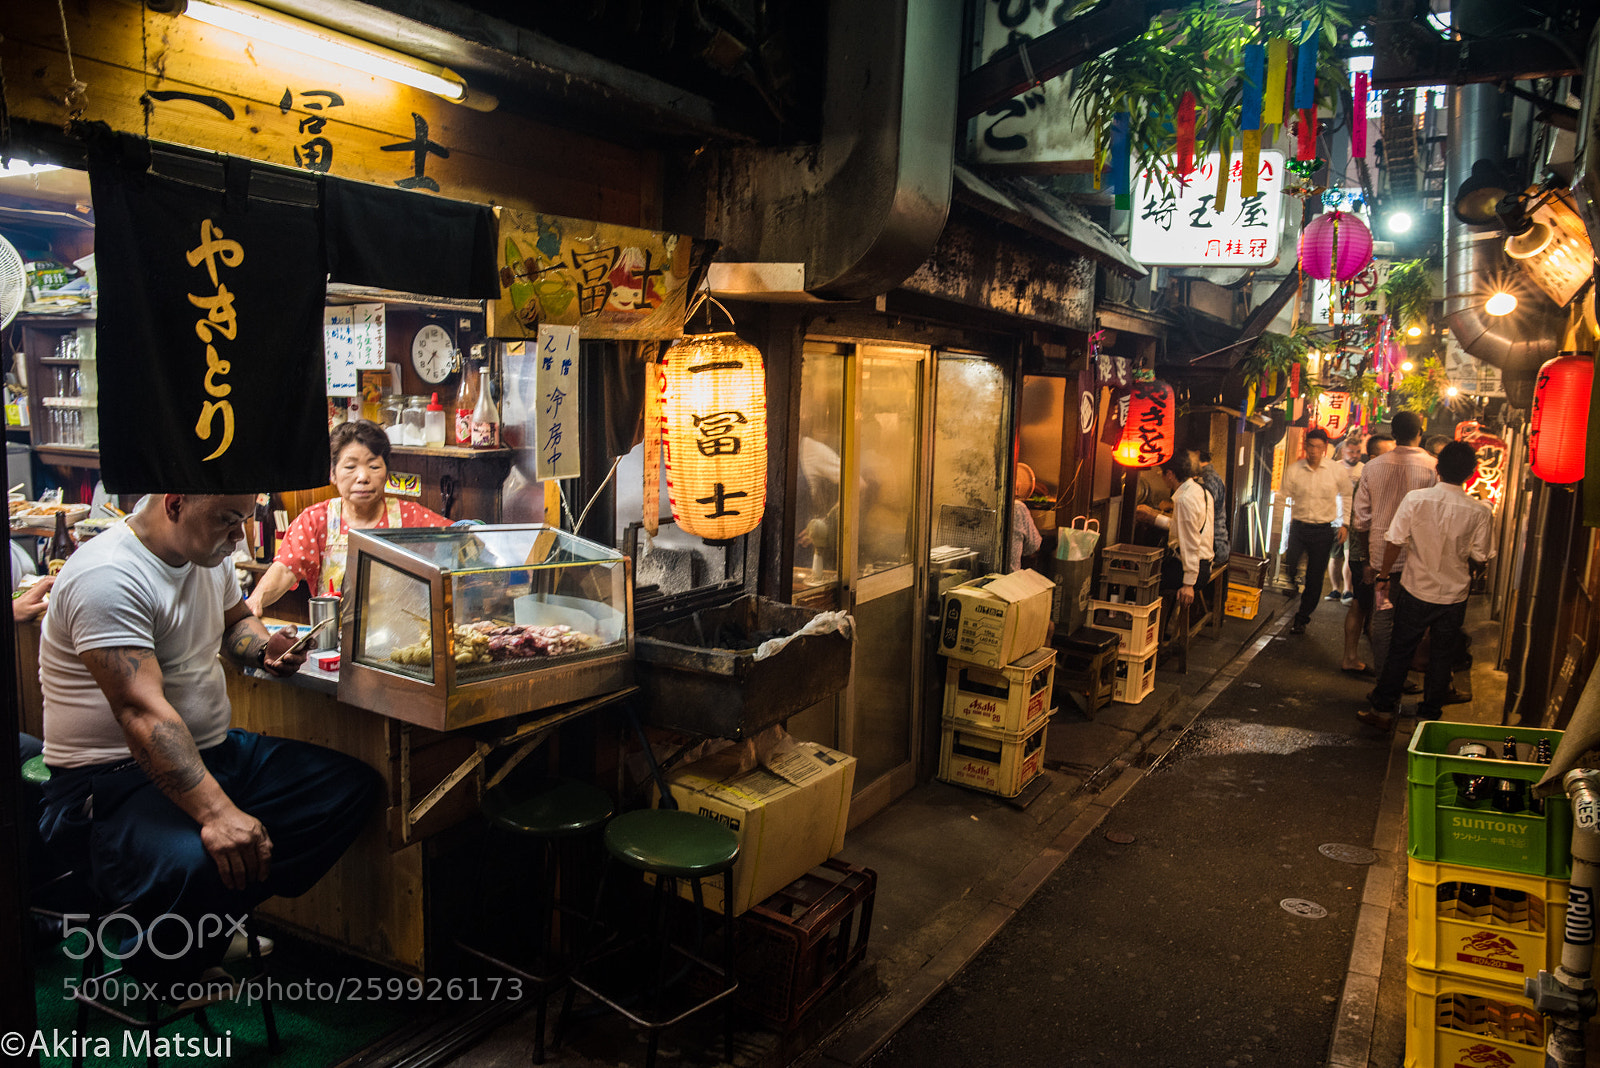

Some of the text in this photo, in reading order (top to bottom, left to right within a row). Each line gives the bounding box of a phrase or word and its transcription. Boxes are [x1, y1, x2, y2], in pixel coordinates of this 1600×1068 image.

[1141, 191, 1268, 231] 埼玉屋
[1205, 239, 1267, 258] 月桂冠
[186, 219, 244, 461] やきとり
[419, 340, 426, 348] 10
[1326, 394, 1345, 429] 若月
[543, 386, 567, 477] 冷房中
[1133, 380, 1169, 464] やきとり
[969, 699, 996, 713] Asahi
[963, 762, 990, 776] Asahi
[1453, 817, 1528, 834] SUNTORY
[1453, 832, 1487, 842] サントリー
